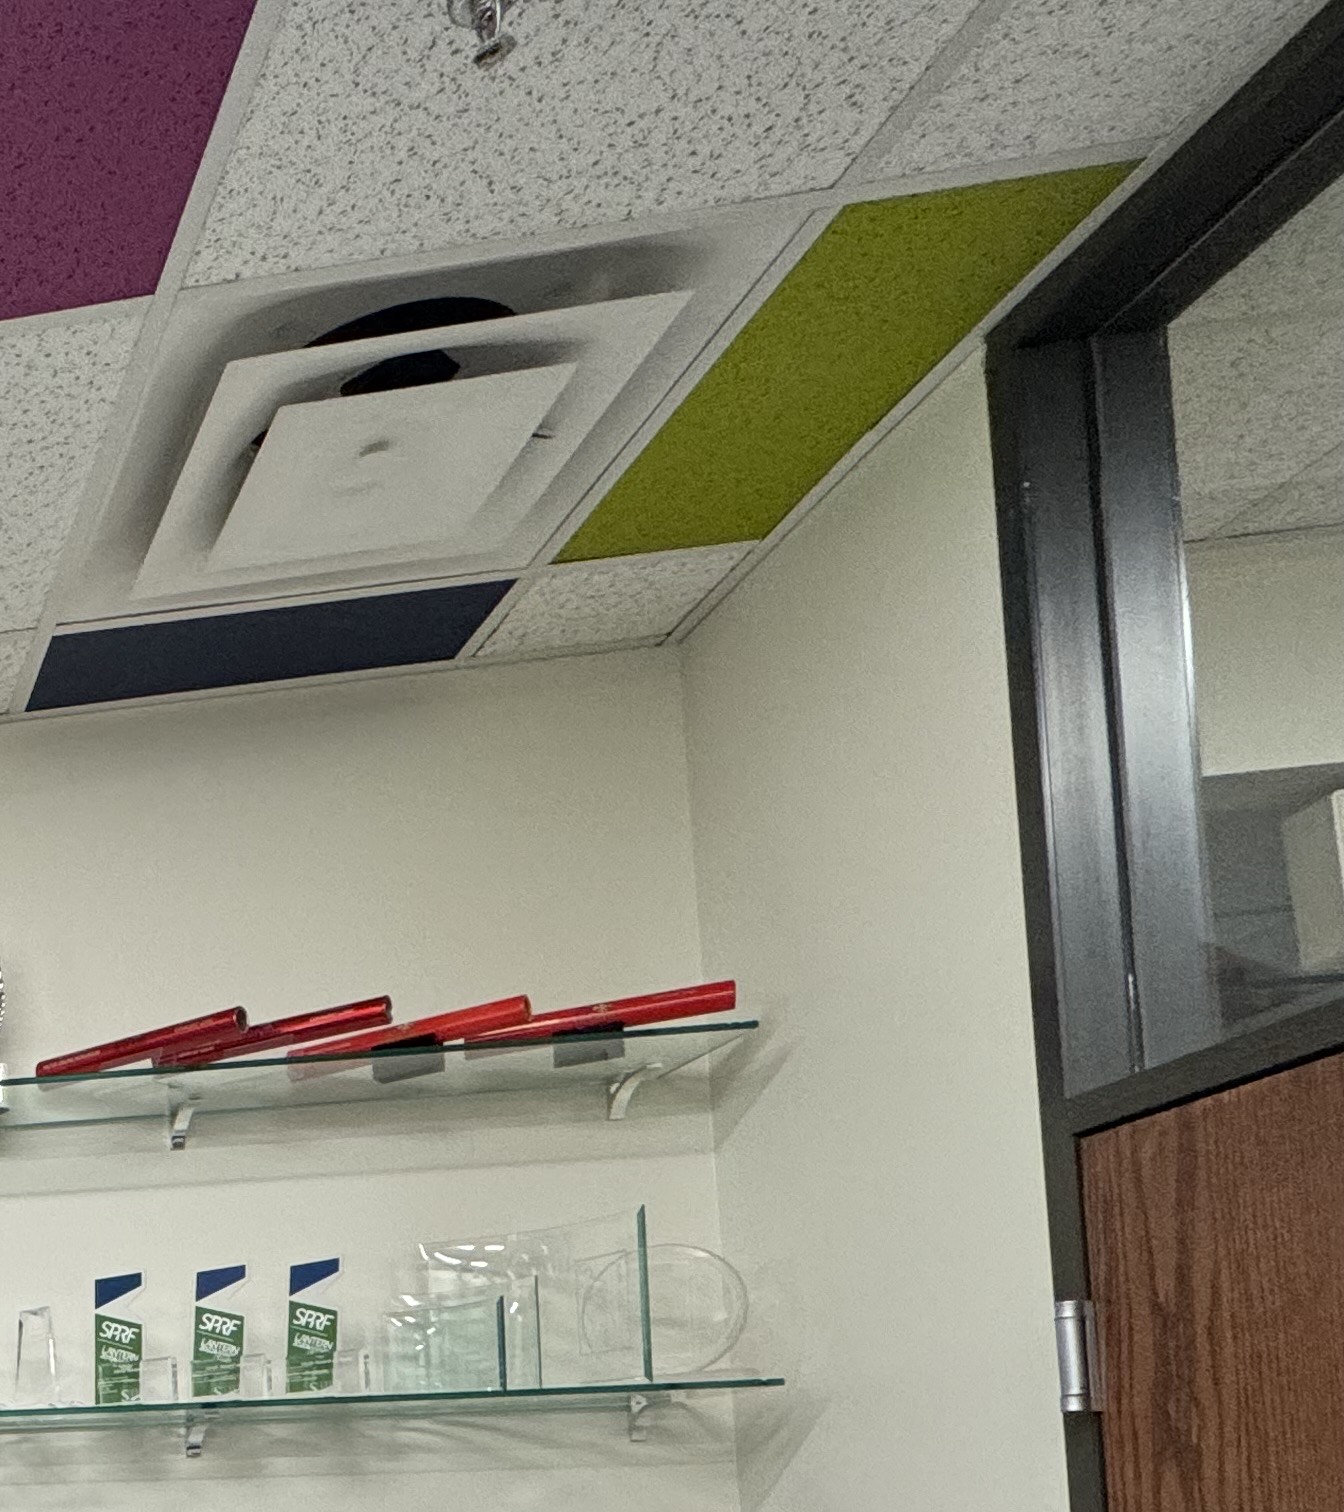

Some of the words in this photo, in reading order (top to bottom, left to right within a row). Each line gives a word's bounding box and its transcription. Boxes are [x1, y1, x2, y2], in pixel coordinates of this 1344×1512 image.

[199, 1313, 242, 1336] SPRF
[292, 1307, 335, 1331] SPRF
[98, 1321, 140, 1344] SPRF
